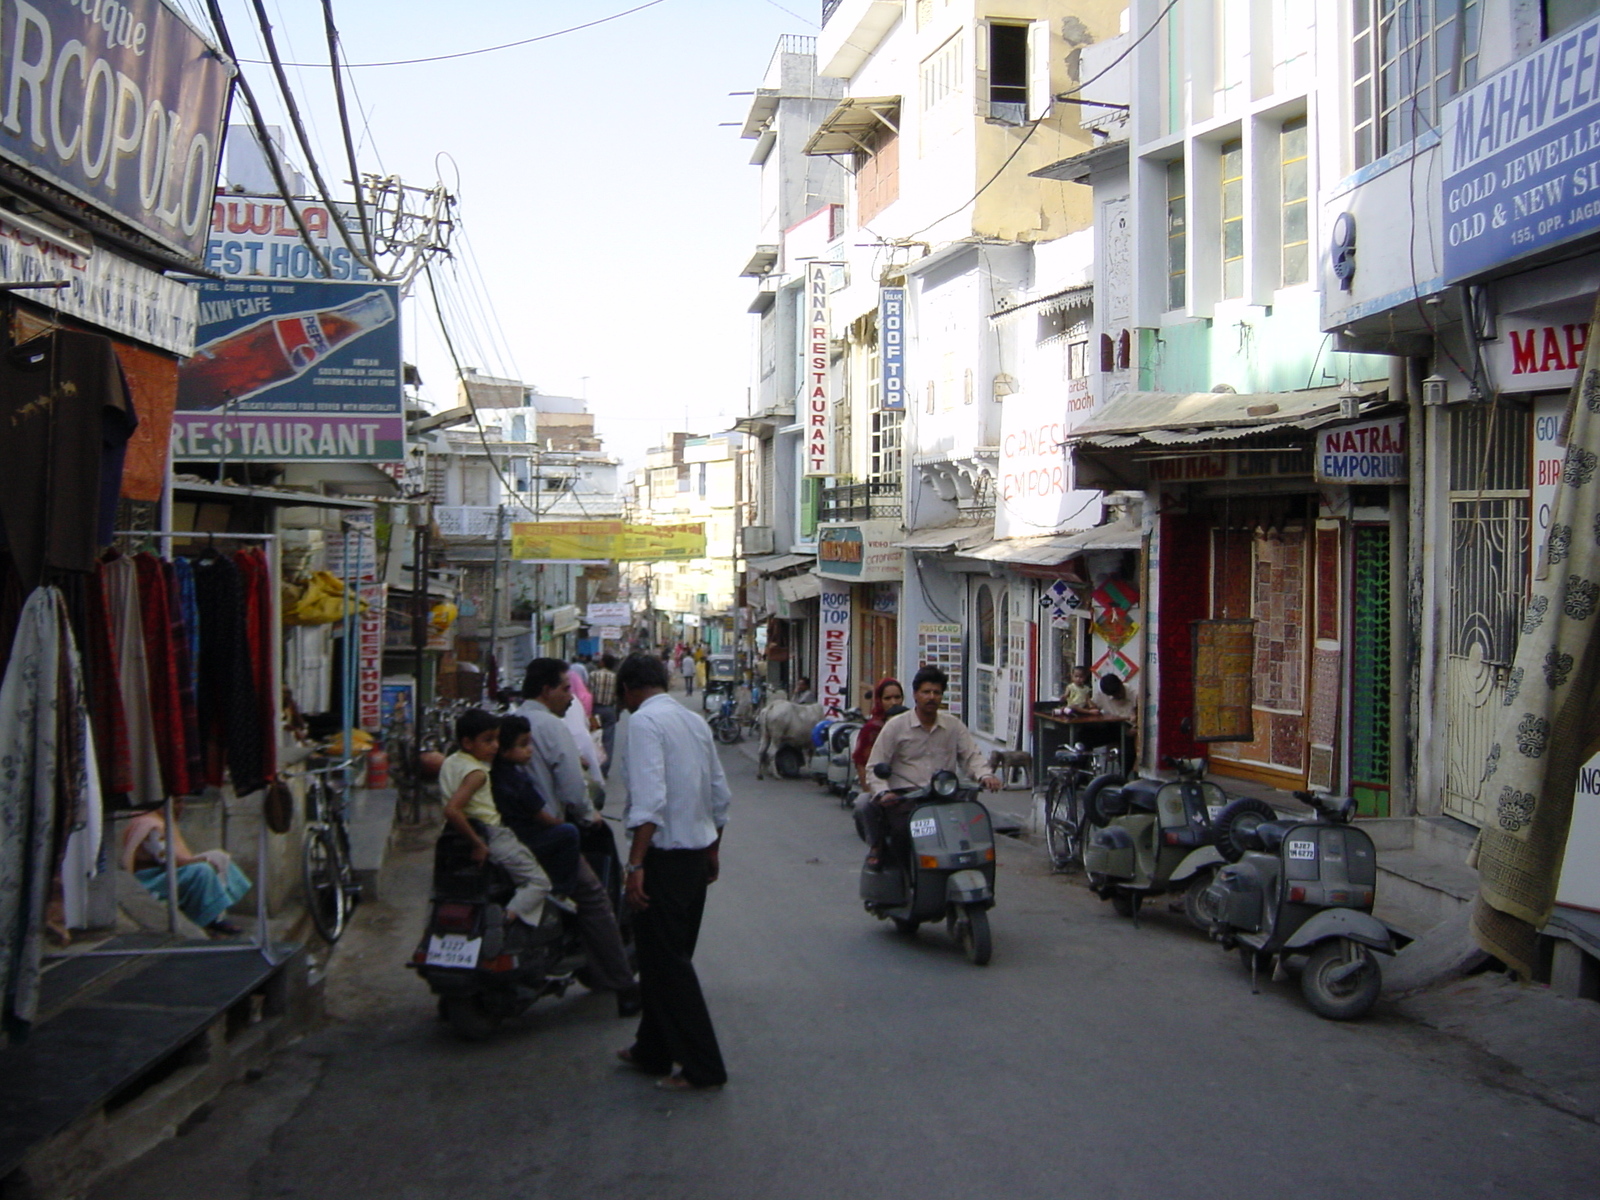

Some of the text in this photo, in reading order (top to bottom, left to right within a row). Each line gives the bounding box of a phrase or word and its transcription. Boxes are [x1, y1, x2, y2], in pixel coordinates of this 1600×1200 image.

[0, 0, 210, 237] RCOPOLO
[1452, 22, 1600, 173] MAHAVEE
[1449, 171, 1497, 214] GOLD
[1449, 159, 1600, 247] OLD & NEW SI
[1510, 227, 1535, 246] 155,
[1538, 216, 1564, 236] OPP.
[269, 243, 372, 281] HOUSE
[236, 296, 272, 318] CAFE
[886, 302, 900, 359] ROOF
[811, 268, 826, 471] ANNA RESTAURANT
[886, 362, 900, 405] TOP
[172, 421, 380, 457] RESTAURANT
[1326, 421, 1406, 454] NATRAJ
[822, 592, 850, 609] ROOF
[823, 609, 849, 625] TOP
[361, 670, 379, 727] HOUSE
